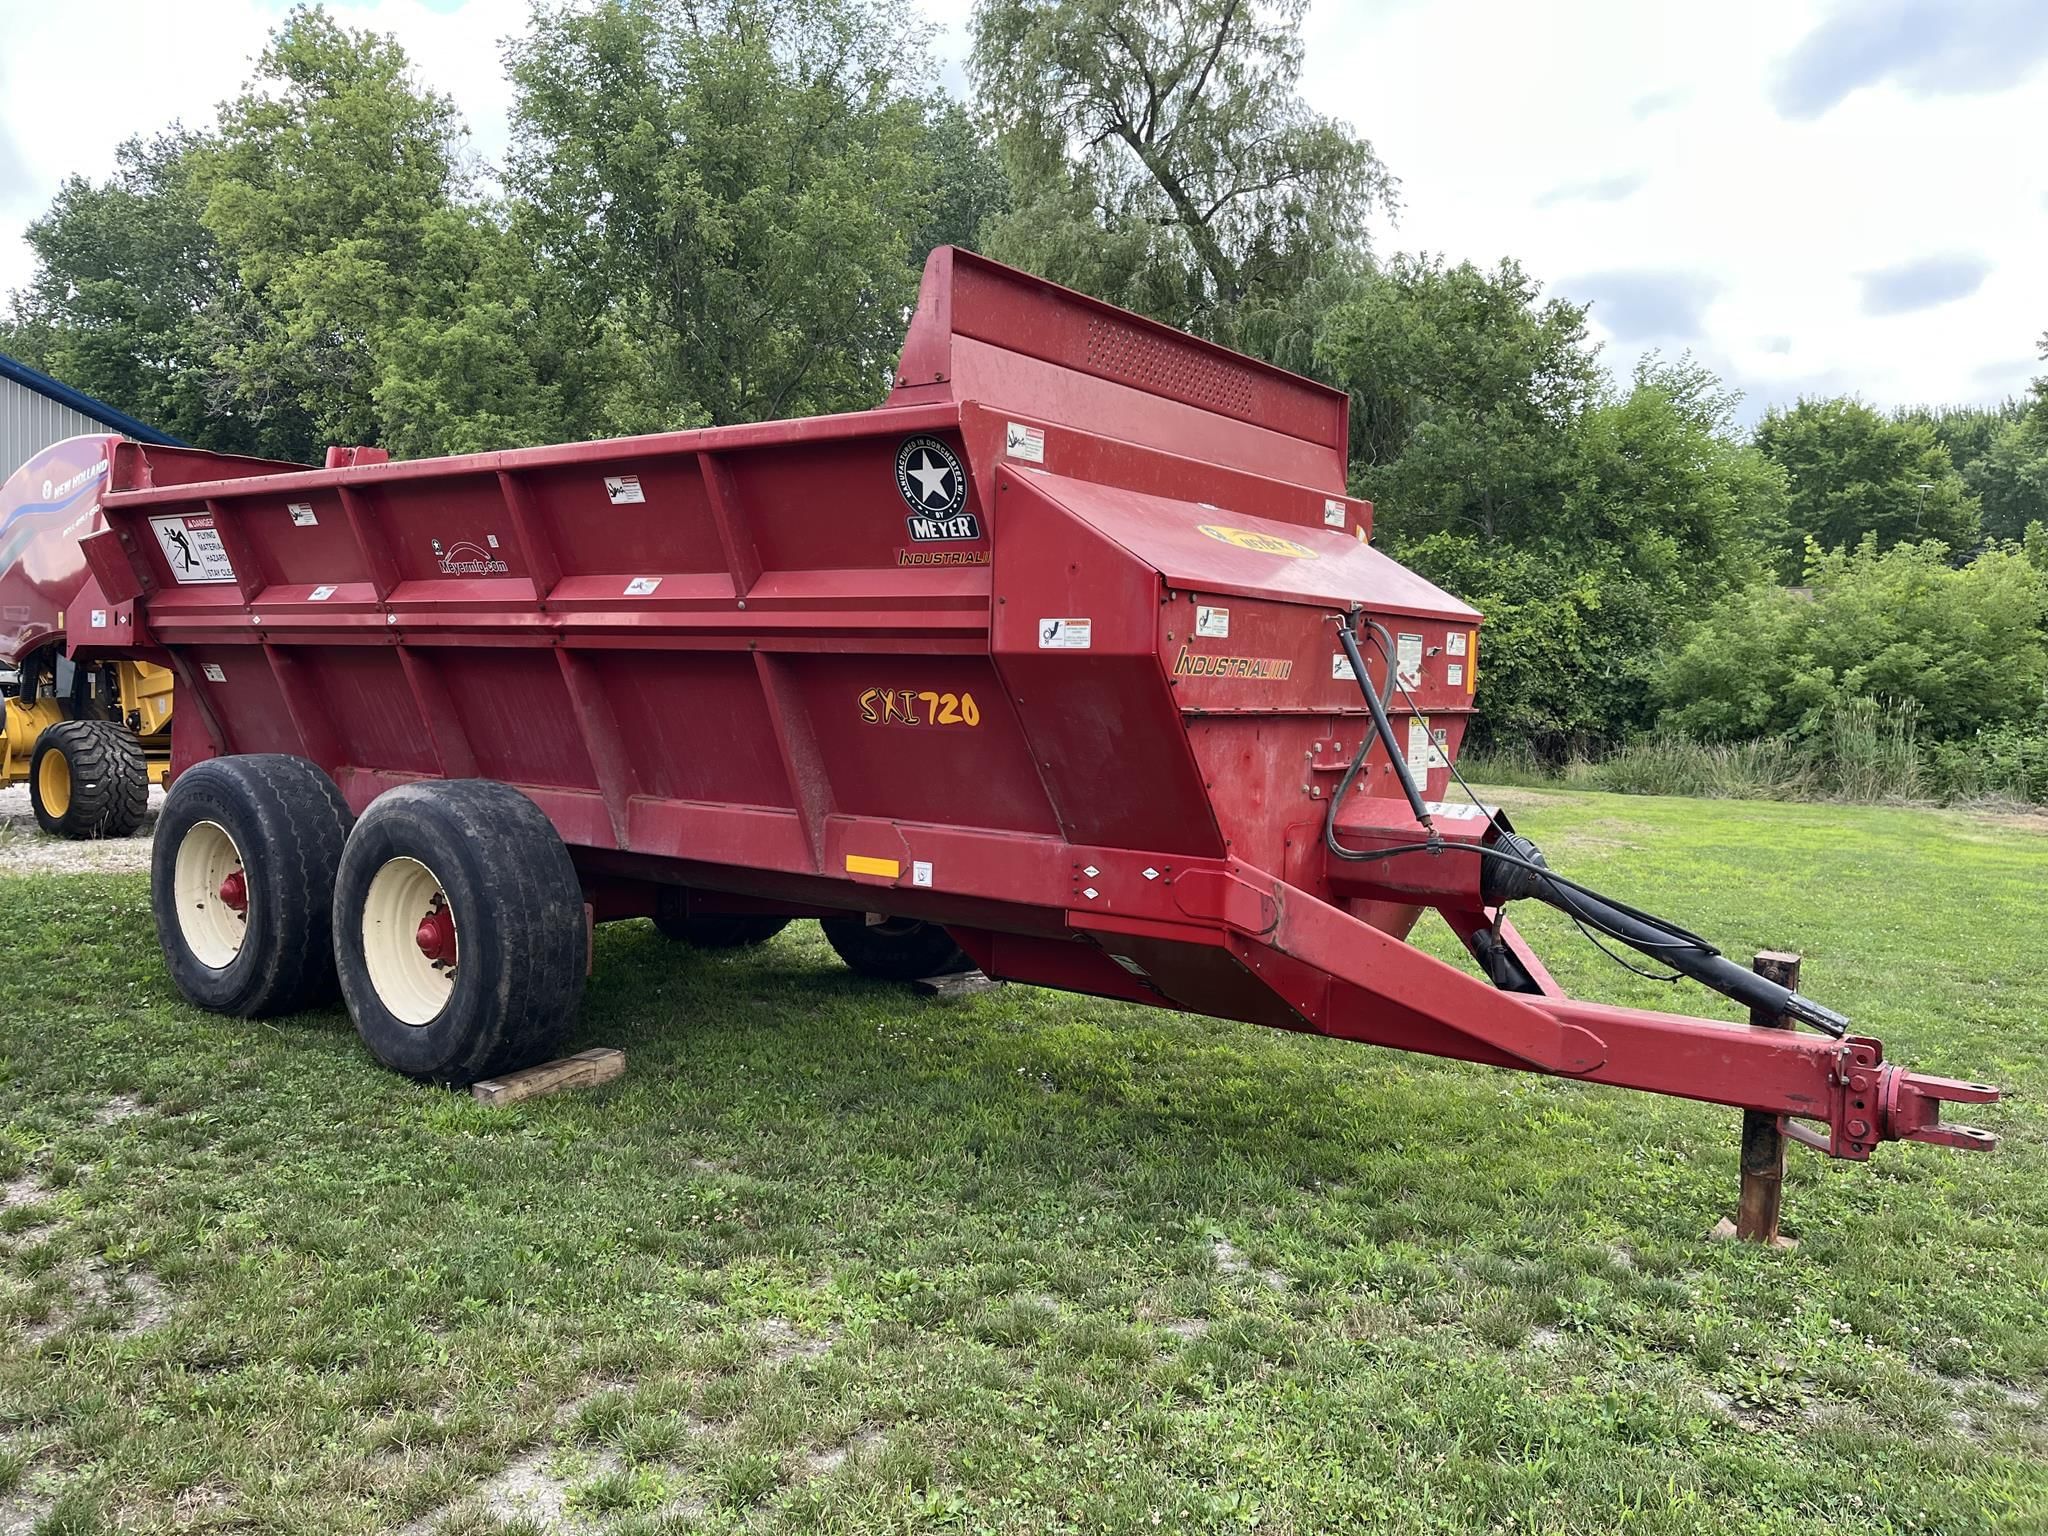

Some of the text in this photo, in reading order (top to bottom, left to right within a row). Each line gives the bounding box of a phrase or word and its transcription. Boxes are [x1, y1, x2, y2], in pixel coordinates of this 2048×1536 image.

[54, 458, 108, 500] NEW HOLLAND
[898, 441, 917, 498] MANUFACTURED
[926, 439, 963, 482] DORCHESTER
[935, 511, 944, 519] BY
